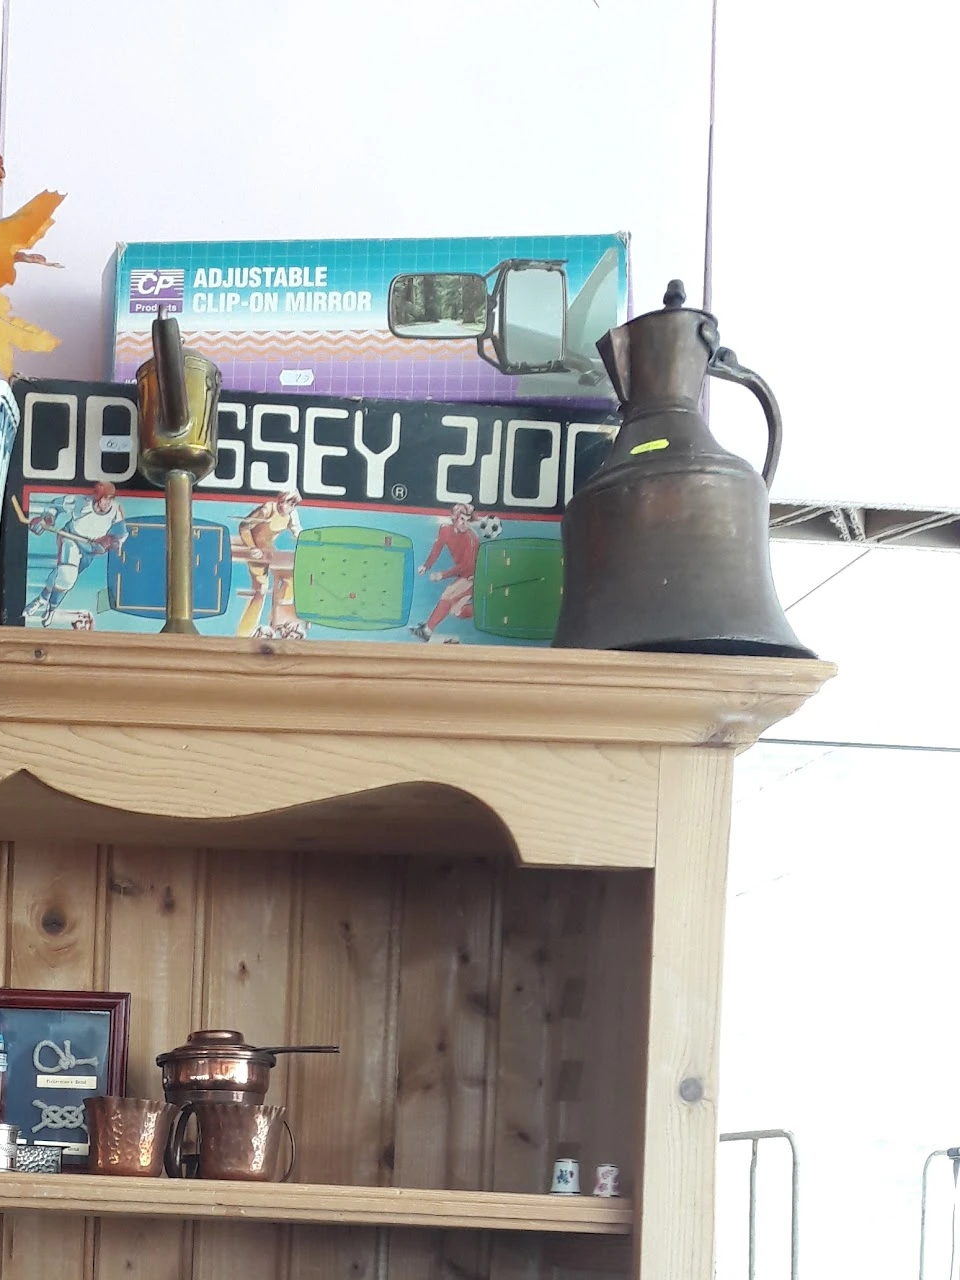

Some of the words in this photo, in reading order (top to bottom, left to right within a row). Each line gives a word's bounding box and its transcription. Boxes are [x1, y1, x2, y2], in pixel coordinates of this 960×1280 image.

[137, 273, 175, 296] CP
[192, 266, 328, 288] ADJUSTABLE
[135, 303, 177, 312] Prodts
[192, 291, 282, 314] CLIP-ON
[285, 291, 372, 313] MIRROR
[22, 391, 402, 499] ODSSEY
